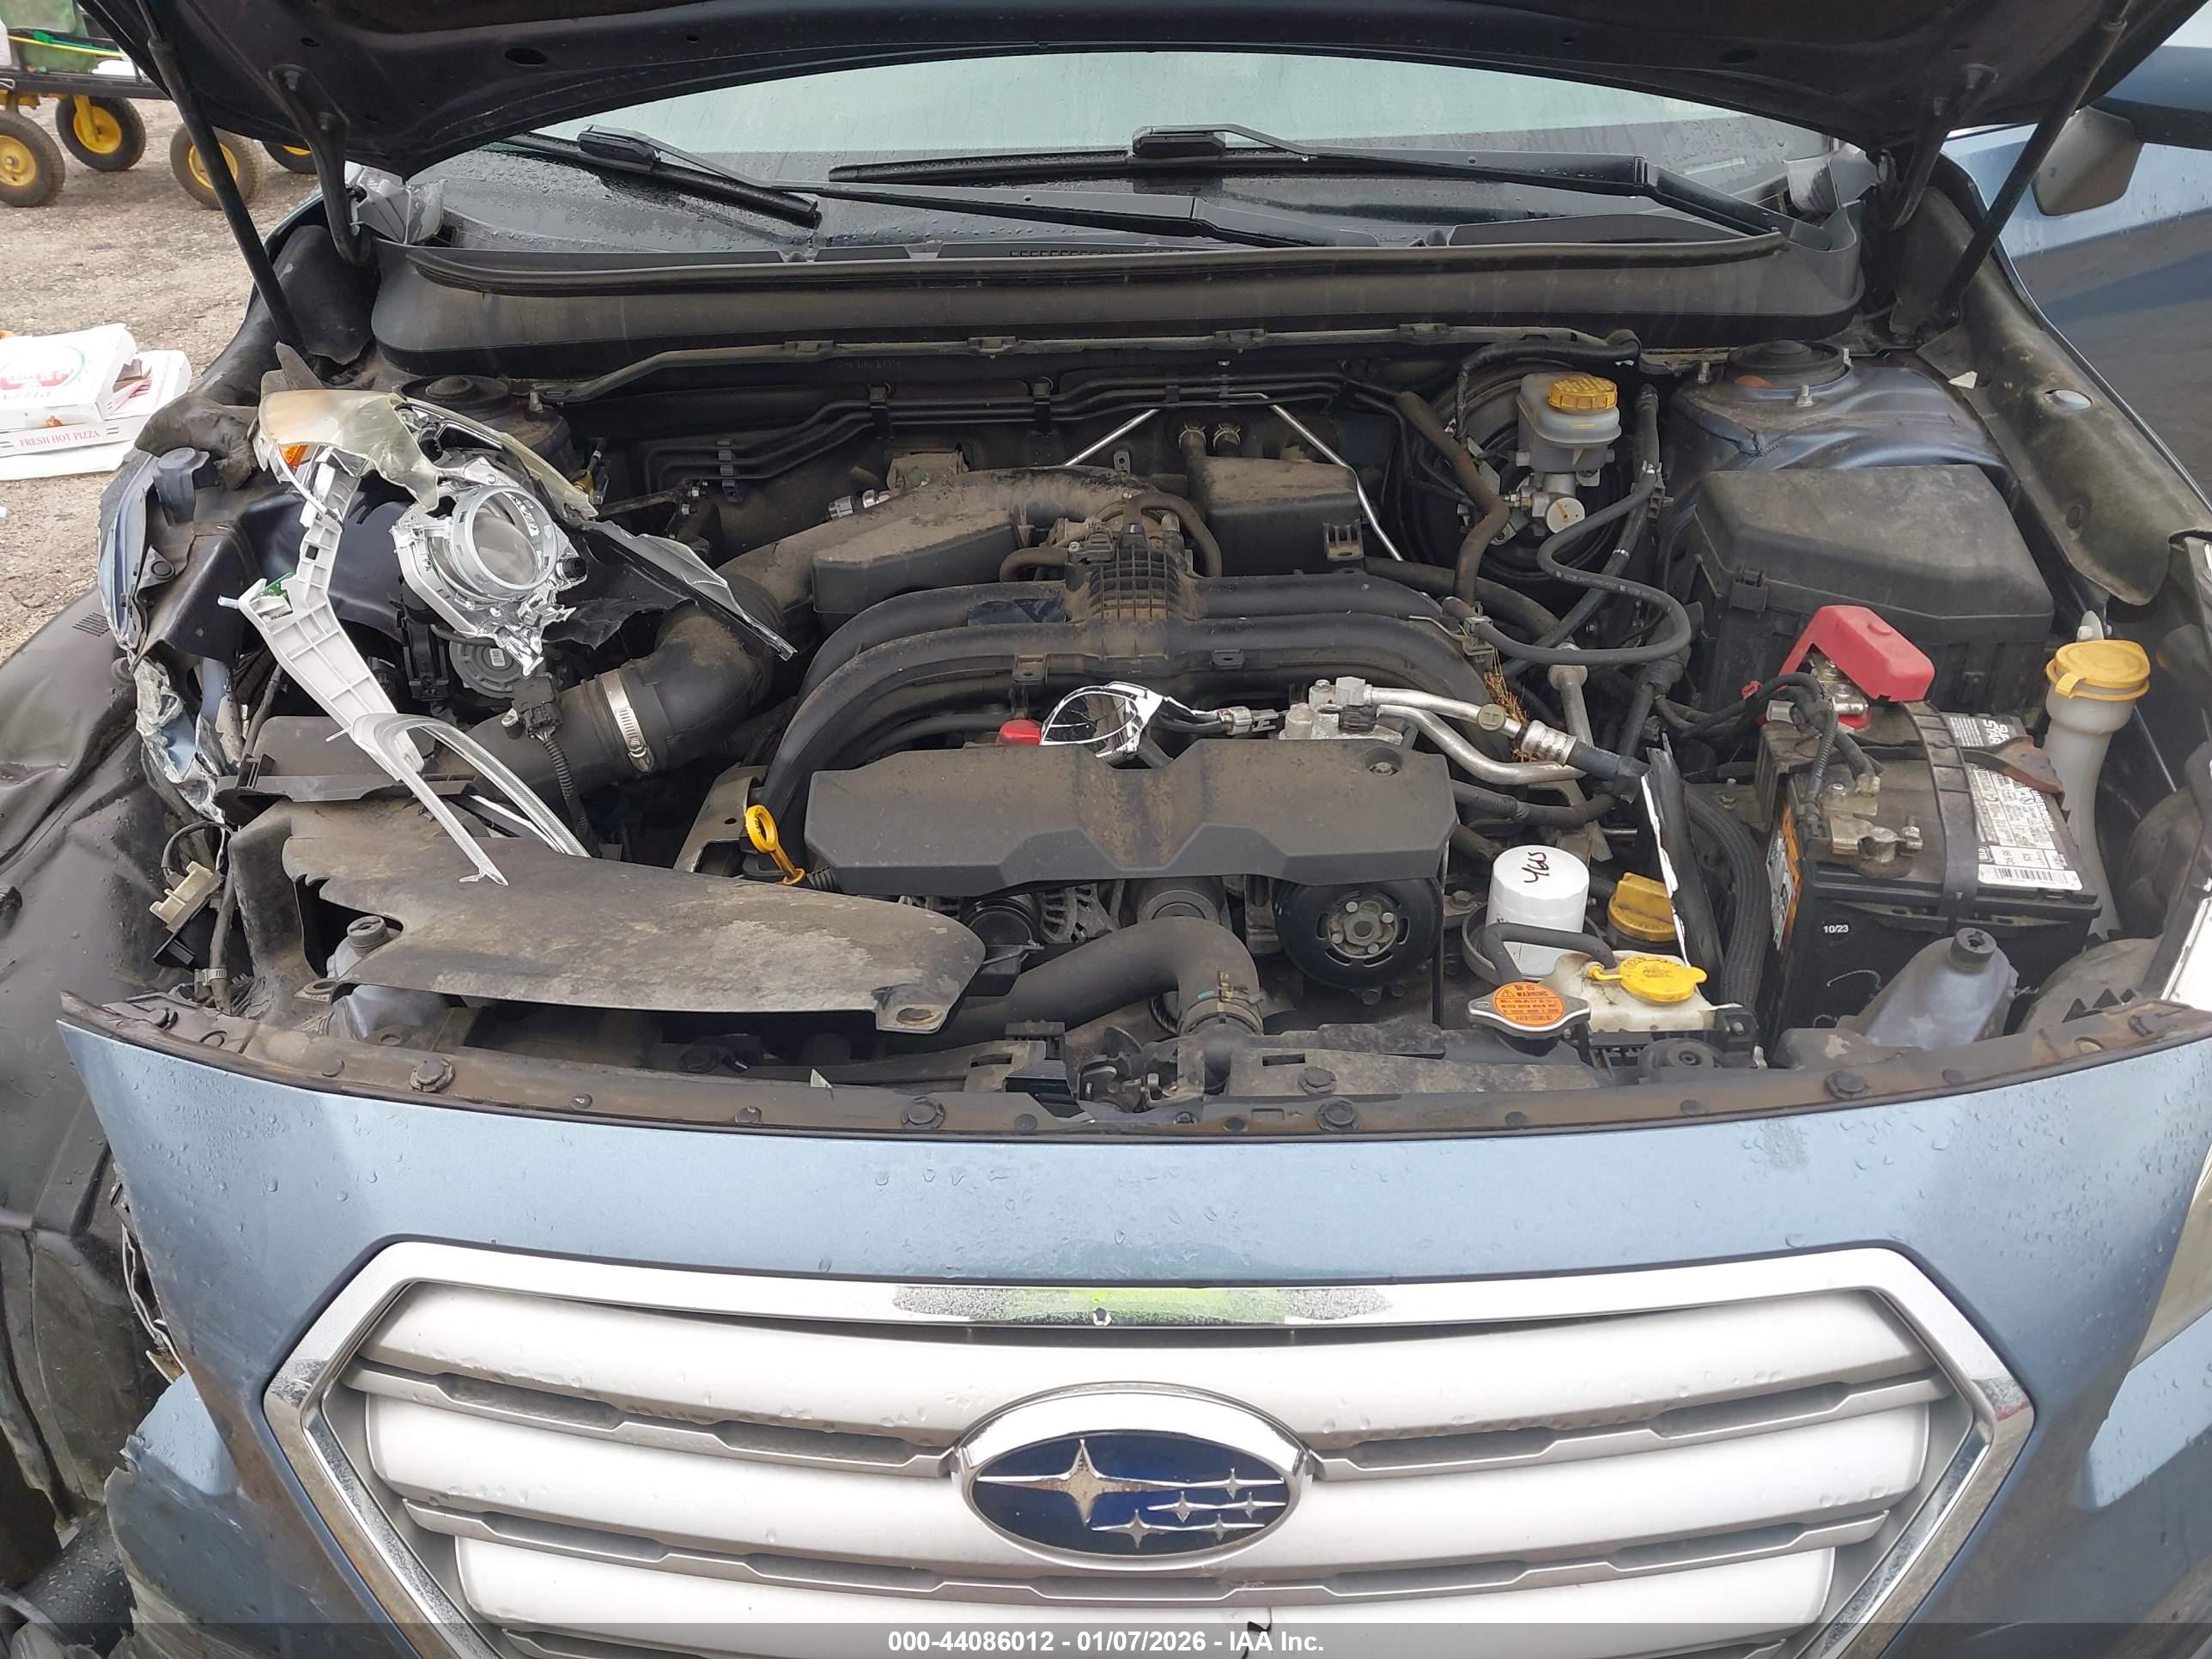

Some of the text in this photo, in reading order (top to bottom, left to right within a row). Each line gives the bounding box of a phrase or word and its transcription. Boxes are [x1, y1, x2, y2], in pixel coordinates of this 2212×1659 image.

[19, 429, 100, 447] FRESH HOT PIZZA
[1823, 924, 1849, 934] 10/23
